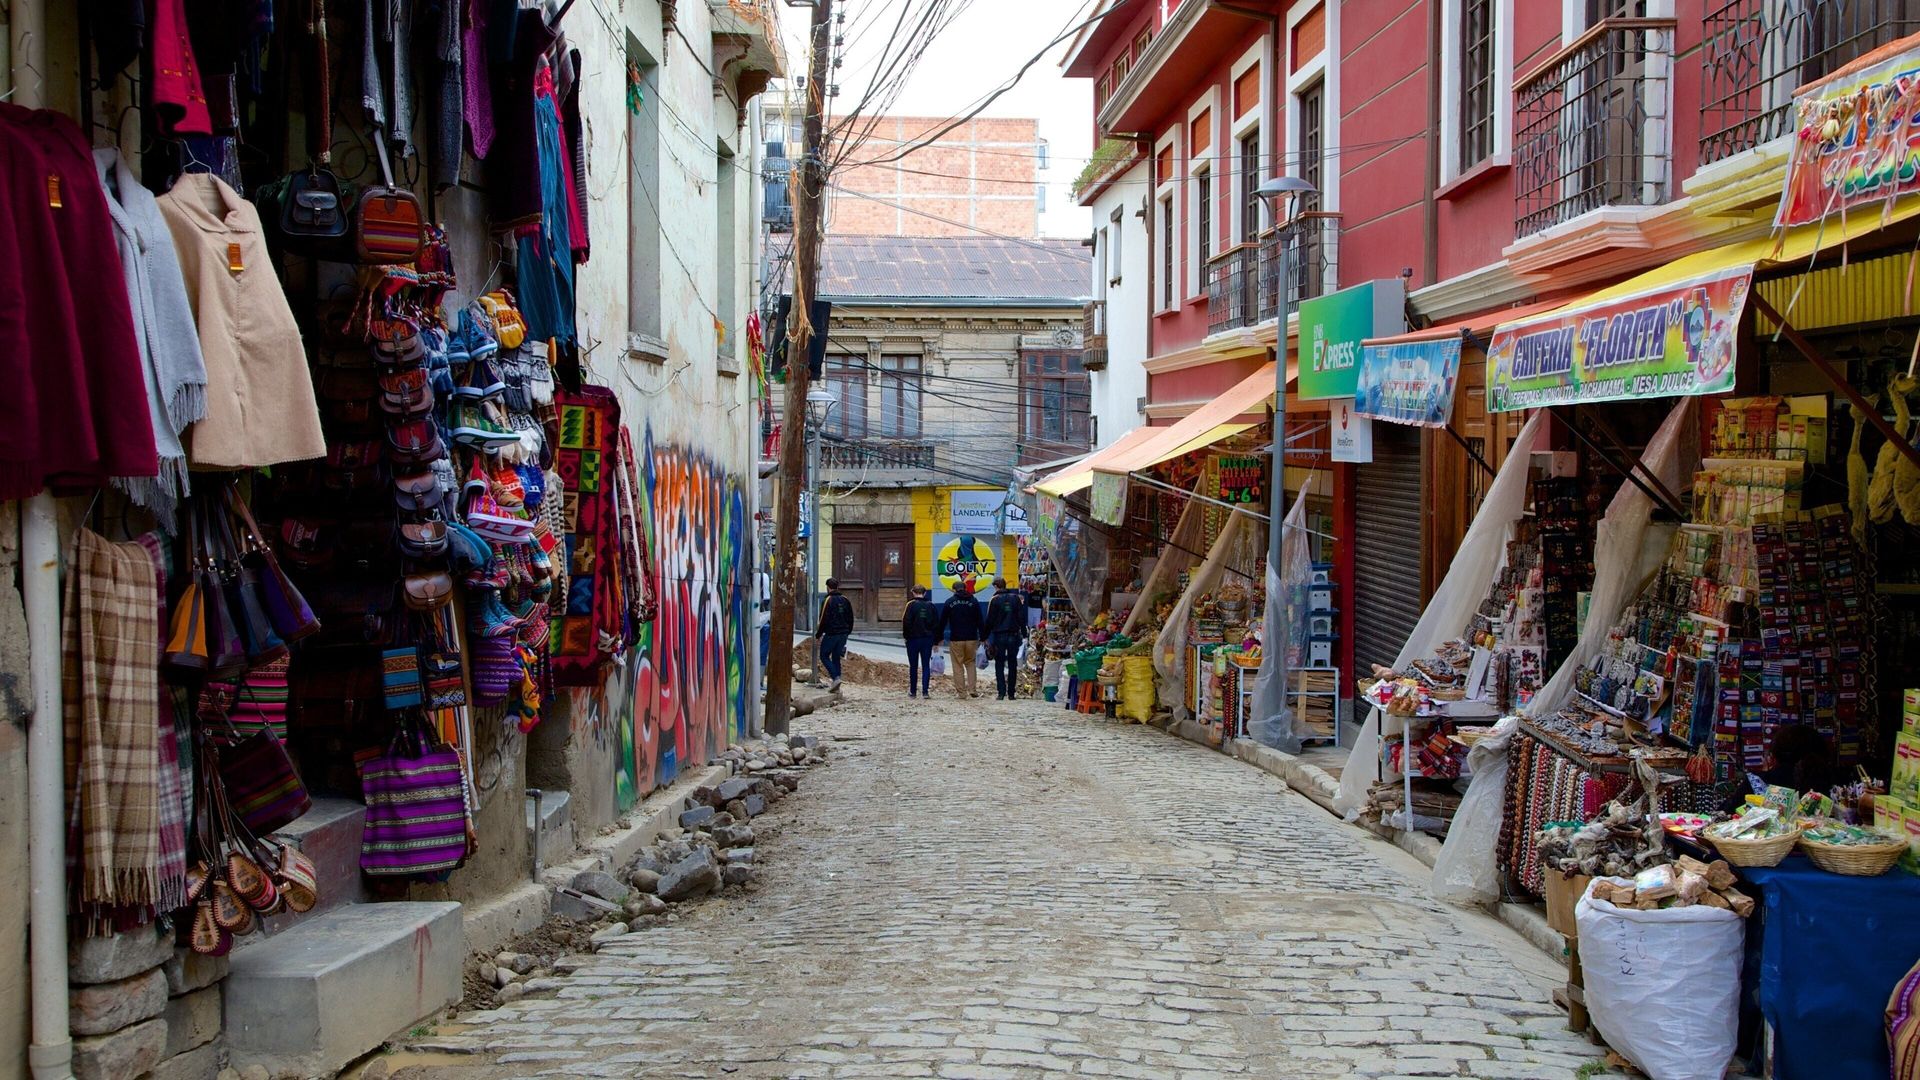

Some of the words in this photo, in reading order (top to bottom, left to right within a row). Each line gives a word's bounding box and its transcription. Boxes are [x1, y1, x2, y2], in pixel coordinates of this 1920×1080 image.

[1313, 339, 1355, 372] EXPRESS
[1511, 325, 1576, 380] CHIFERIA
[1580, 377, 1625, 399] PACHAMAMA
[1632, 373, 1658, 393] MESA
[1660, 370, 1694, 392] DULCE
[953, 509, 995, 517] LANDAETA
[946, 562, 988, 573] GOLTY
